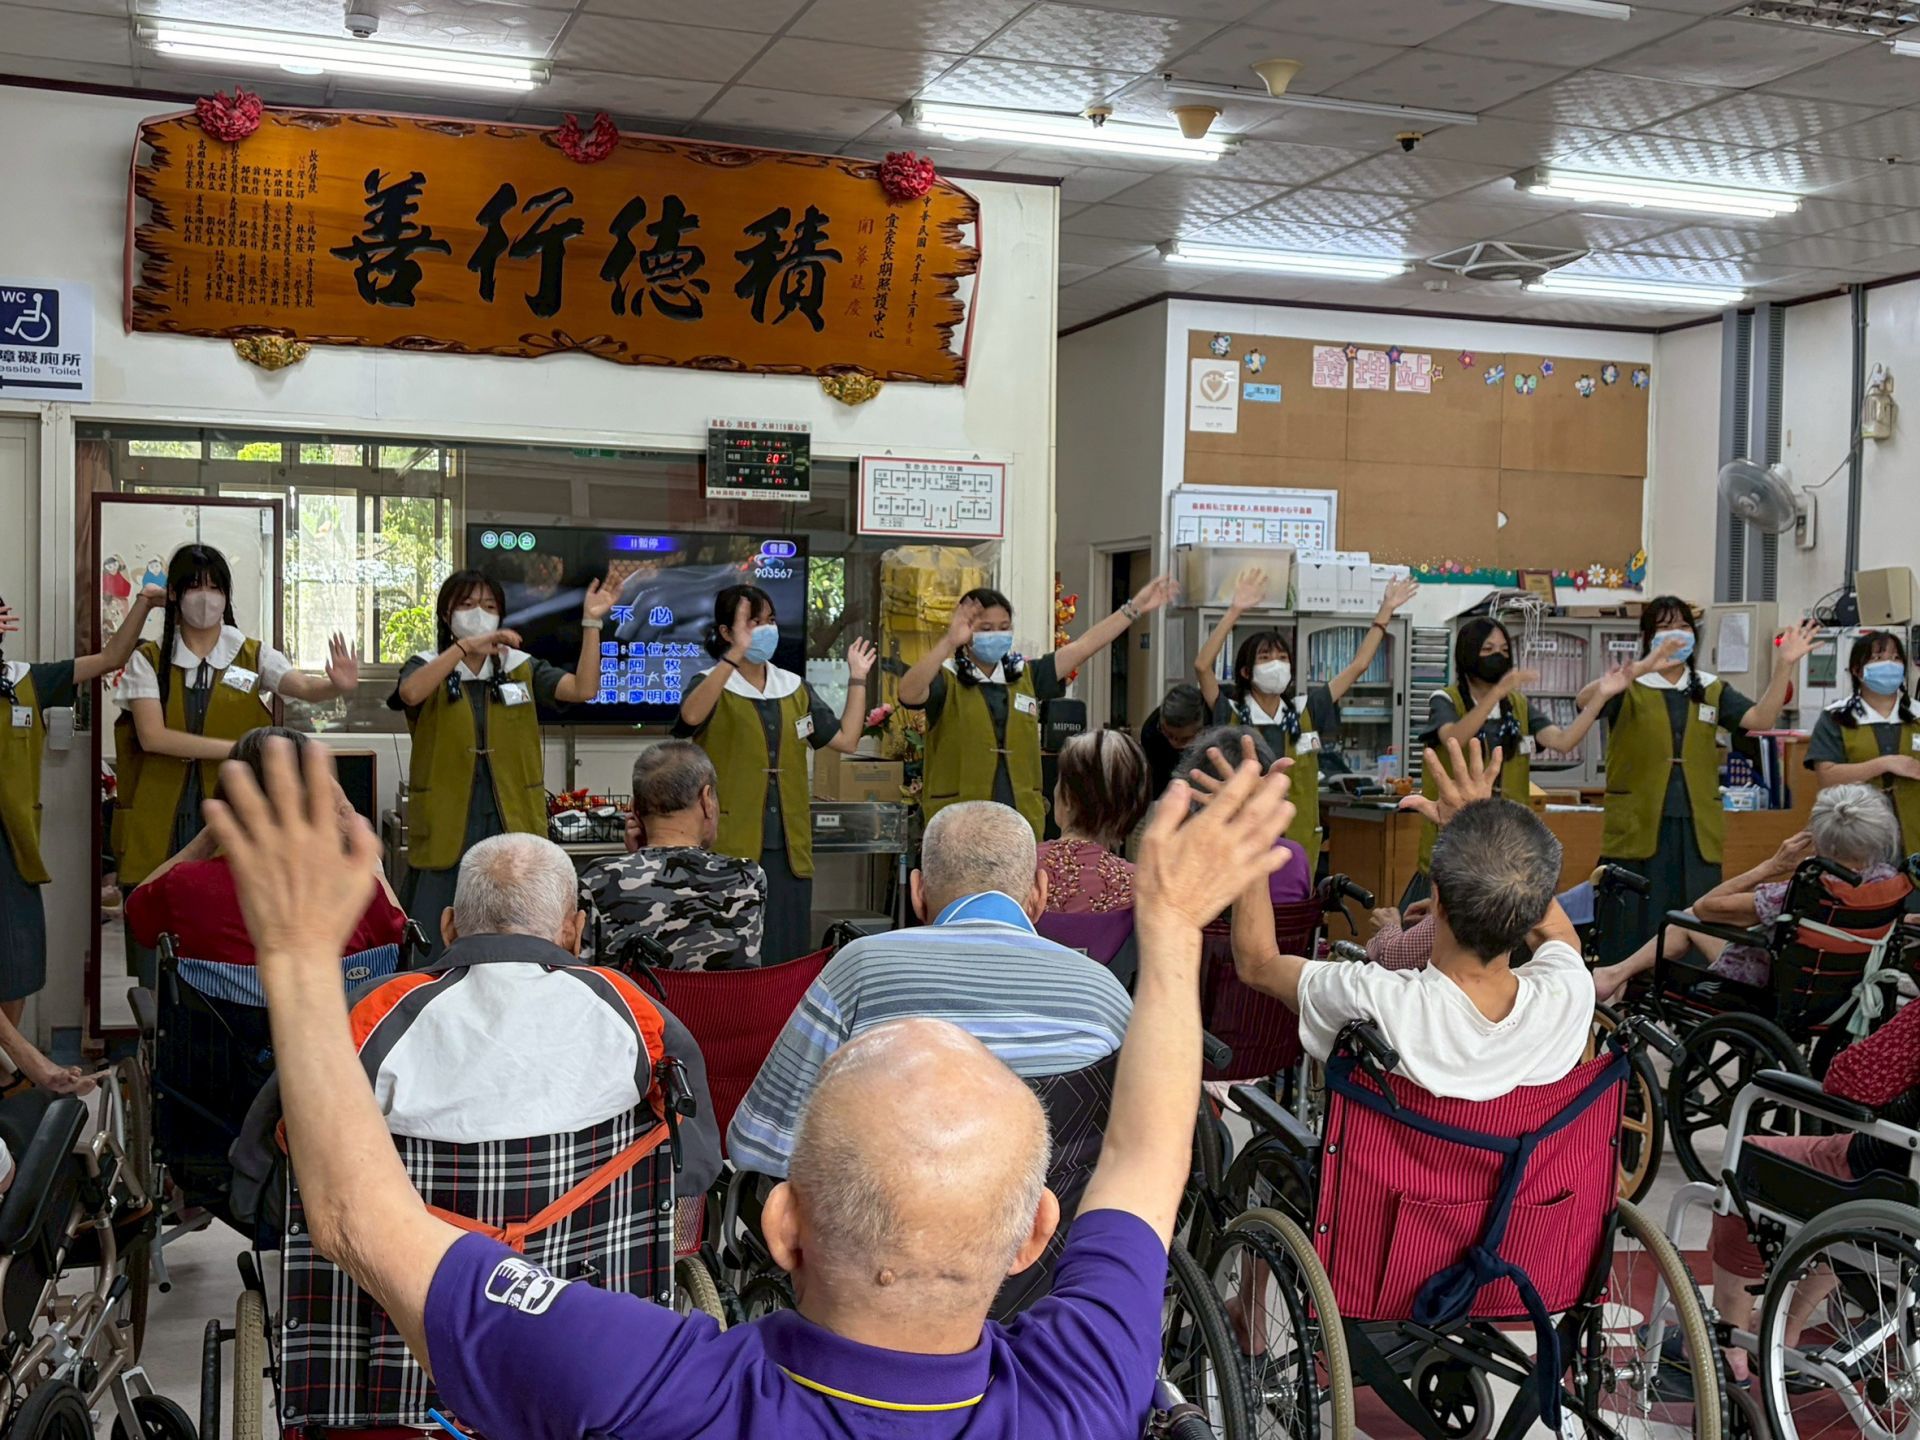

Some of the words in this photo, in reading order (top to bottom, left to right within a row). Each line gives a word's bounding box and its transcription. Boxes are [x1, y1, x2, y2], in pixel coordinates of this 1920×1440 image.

[2, 290, 26, 303] WC
[0, 349, 81, 367] 障礙廁所
[48, 366, 81, 376] Toilet
[755, 568, 792, 579] 903567
[1053, 722, 1081, 731] MIPRO
